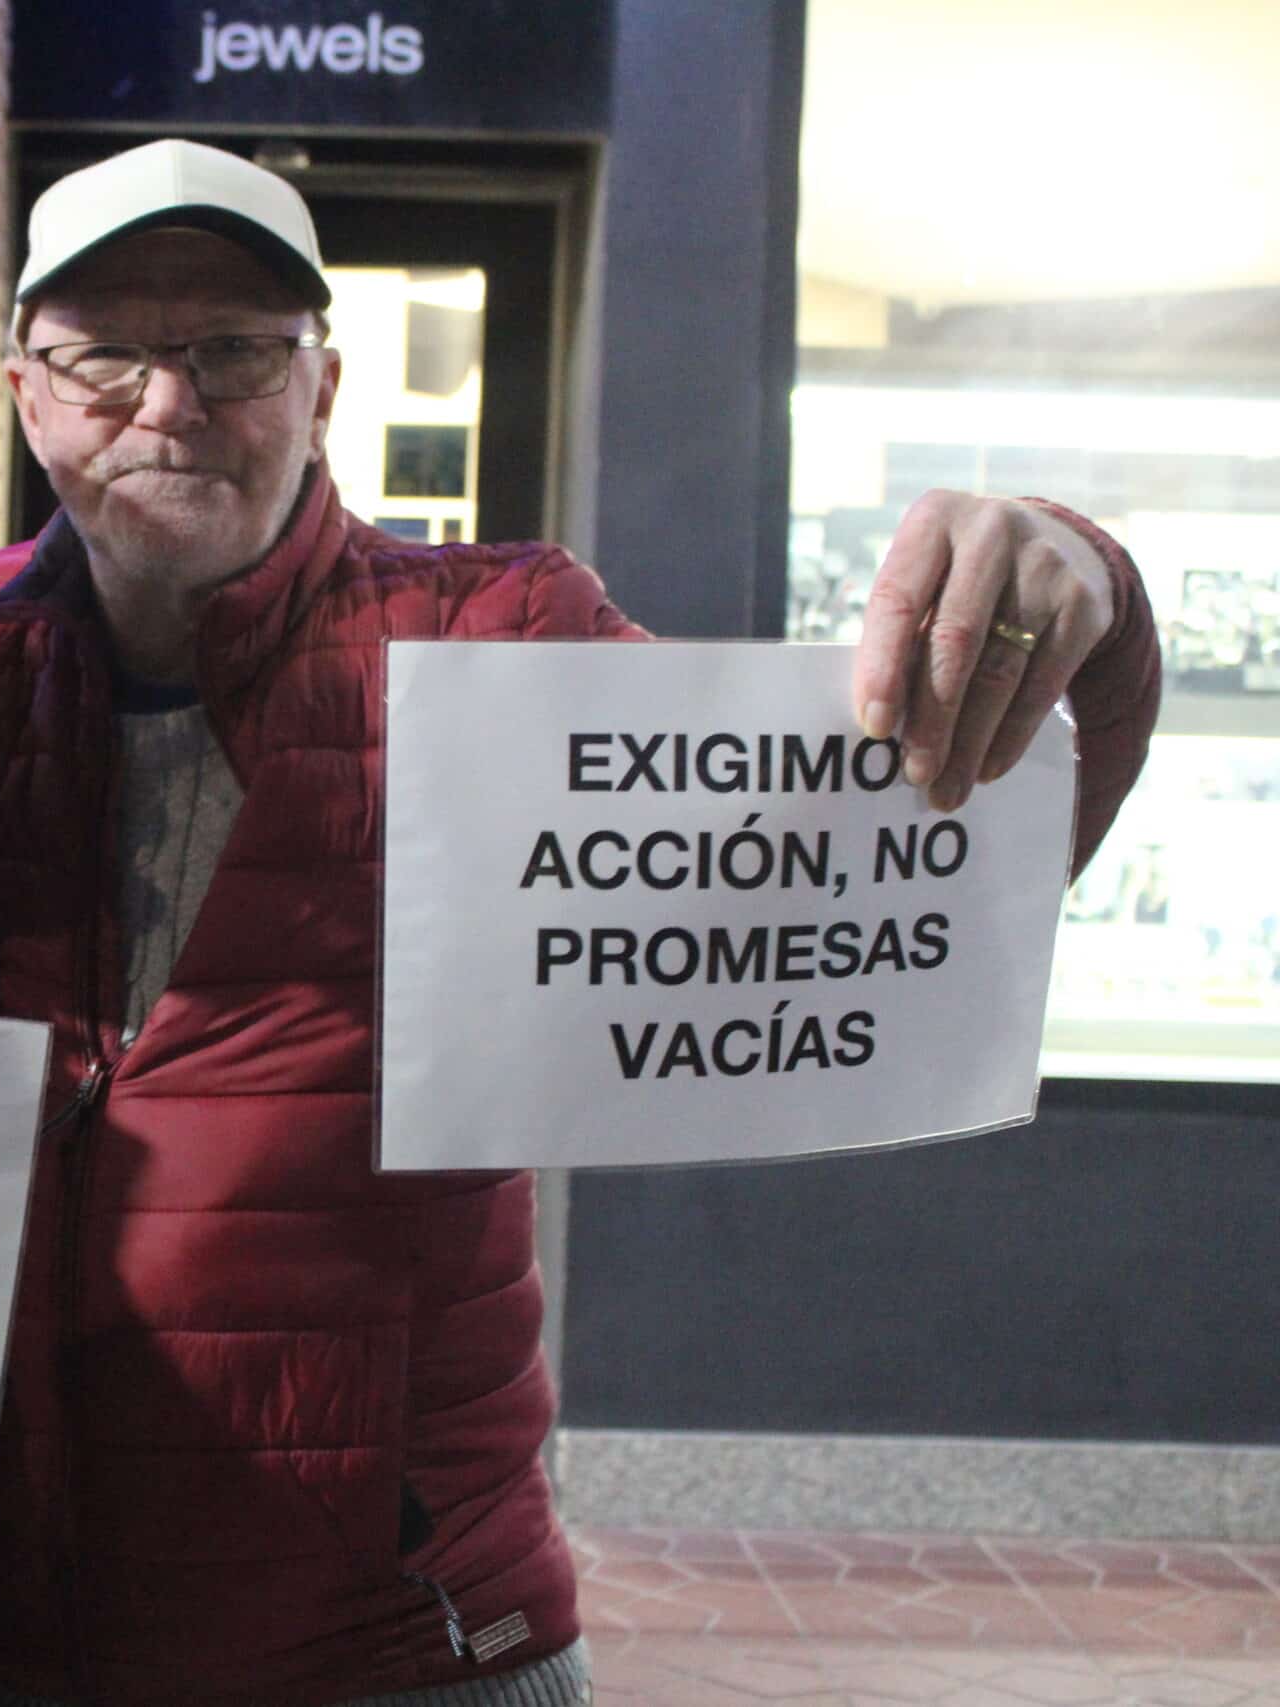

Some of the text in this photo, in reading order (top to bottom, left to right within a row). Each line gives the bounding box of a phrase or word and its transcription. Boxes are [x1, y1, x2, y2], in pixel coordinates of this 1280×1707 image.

[194, 12, 424, 83] jewels
[568, 732, 906, 793] EXIGIMO
[519, 812, 969, 898] ACCIÓN, NO
[535, 912, 950, 986] PROMESAS
[609, 999, 876, 1080] VACÍAS
